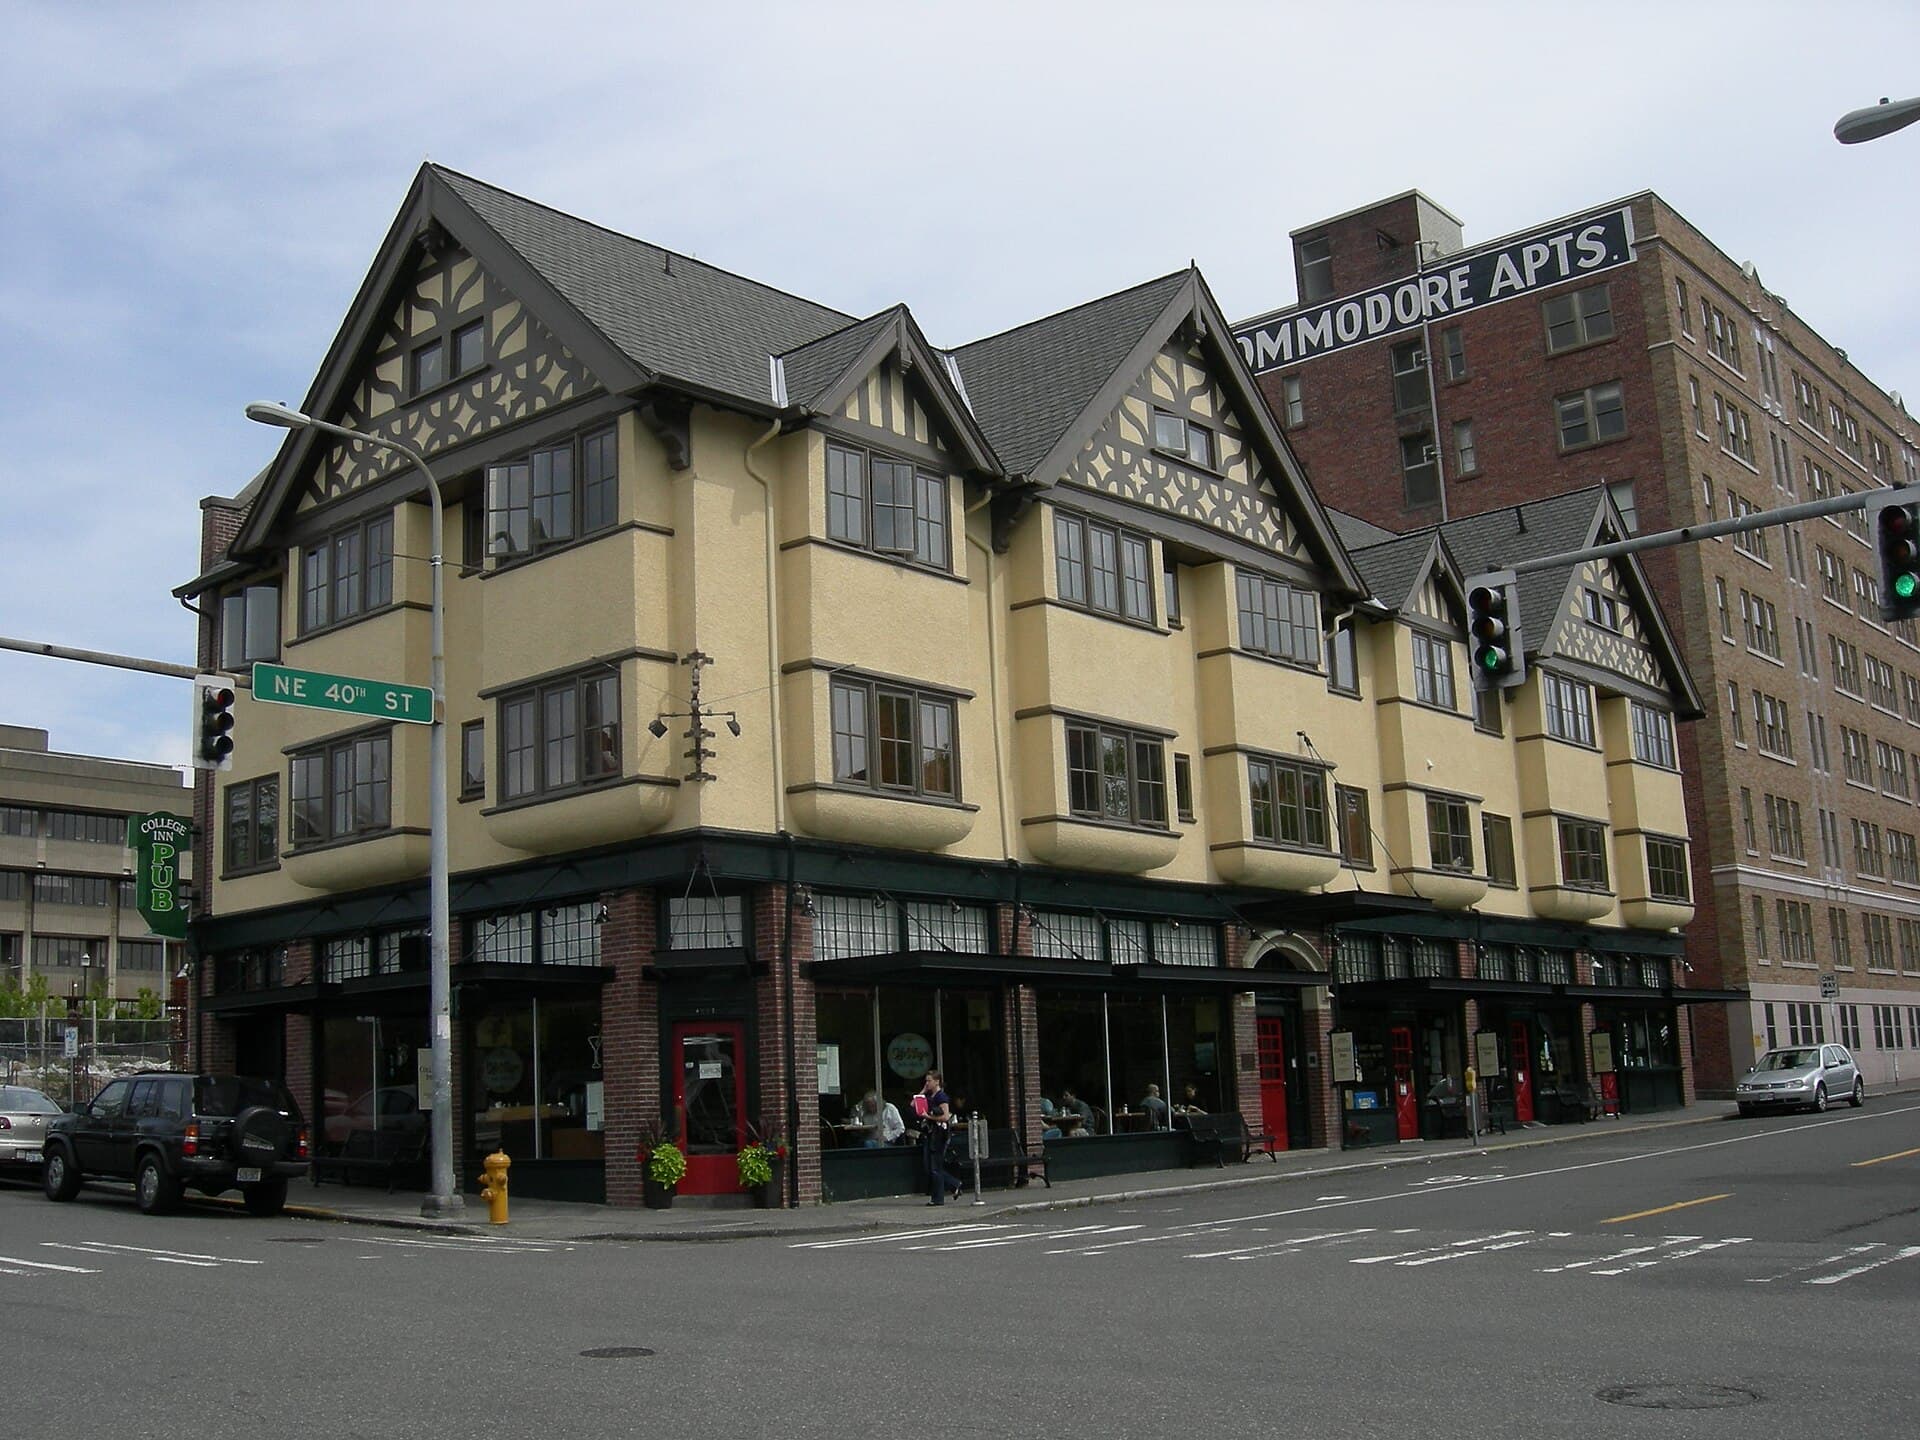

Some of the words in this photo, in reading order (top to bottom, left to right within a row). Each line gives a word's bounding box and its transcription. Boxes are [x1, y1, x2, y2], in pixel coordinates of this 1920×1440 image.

[1489, 225, 1619, 299] APTS.
[275, 675, 306, 697] NE
[325, 684, 366, 704] 40TH
[385, 691, 413, 712] ST
[141, 818, 187, 836] COLLEGE
[153, 830, 174, 842] INN
[151, 842, 175, 911] PUB
